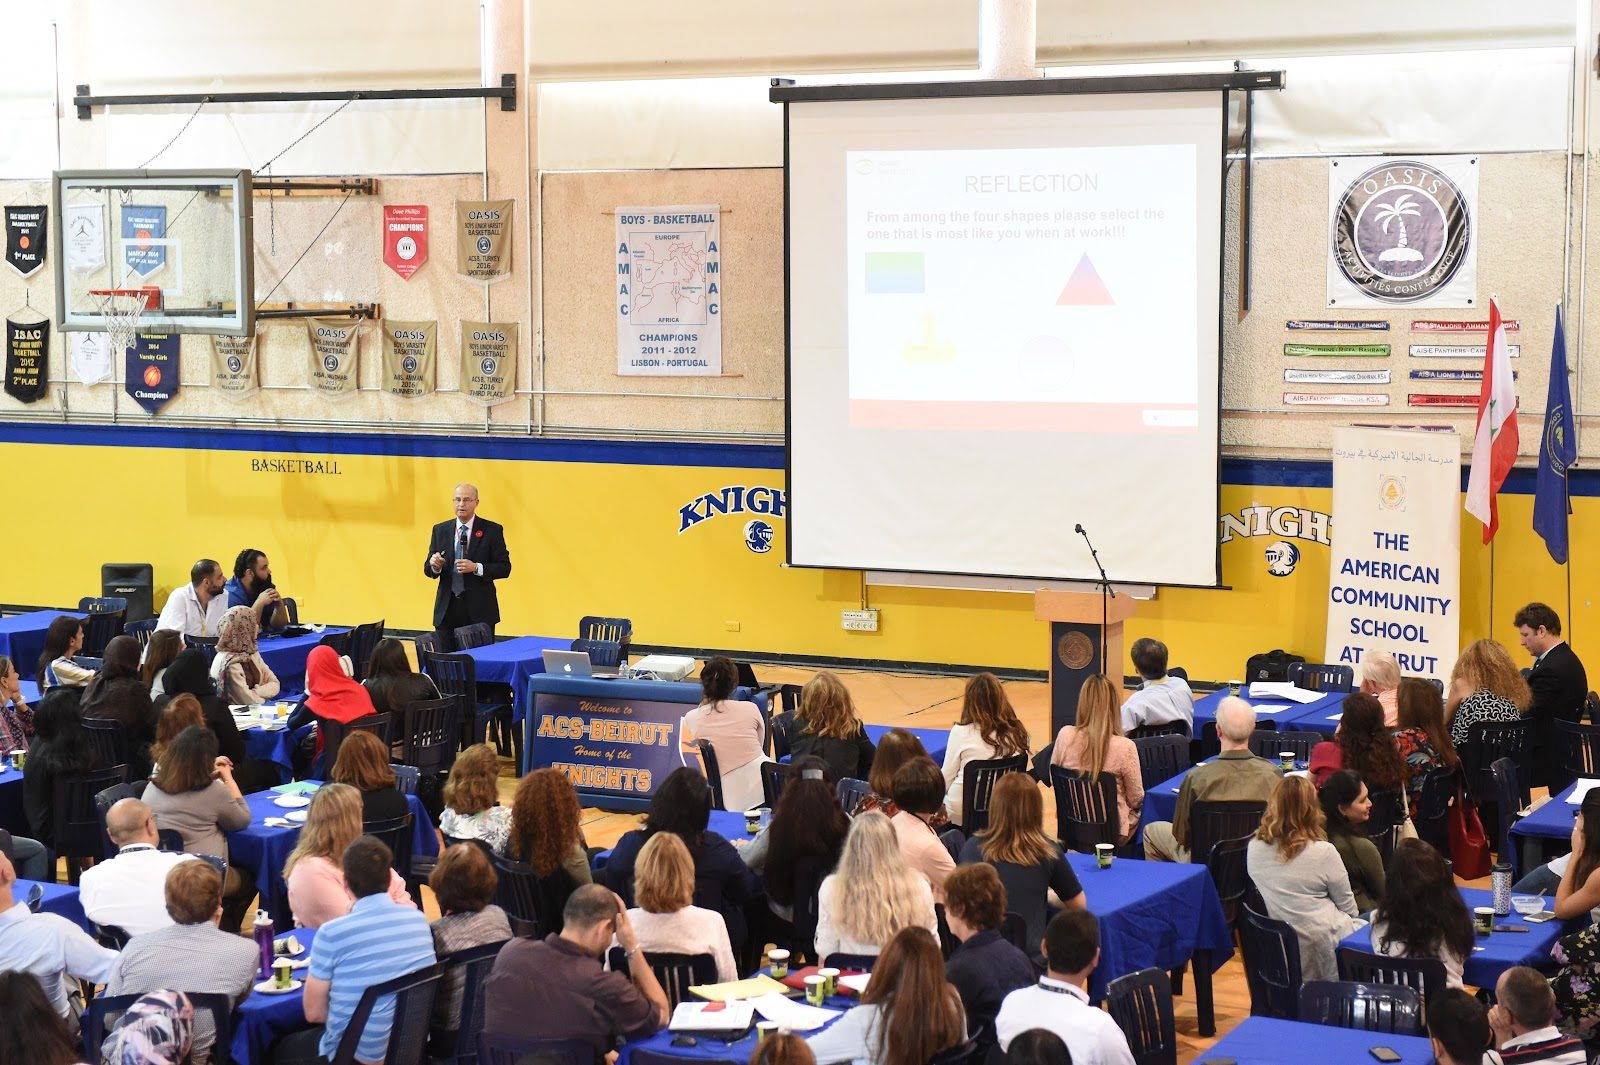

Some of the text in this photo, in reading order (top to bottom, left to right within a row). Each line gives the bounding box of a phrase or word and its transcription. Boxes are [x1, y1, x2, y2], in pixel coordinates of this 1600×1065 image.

[965, 173, 1098, 192] REFLECTION
[1363, 169, 1442, 195] OASIS
[468, 210, 500, 220] OASIS
[620, 215, 645, 224] BOYS
[653, 214, 714, 224] BASKETBALL
[866, 207, 1165, 225] From among the four shapes please select the
[389, 223, 424, 232] CHAMPIONS
[866, 225, 1126, 242] one that is most like you when at work!!!
[1344, 250, 1455, 294] ACTIVITIES CONFERENCE
[14, 330, 41, 340] ISAC
[318, 328, 346, 338] OASIS
[394, 330, 424, 340] OASIS
[473, 332, 504, 341] OASIS
[316, 346, 348, 355] BASKETBALL
[20, 358, 34, 366] 2012
[135, 390, 168, 400] Champions
[1335, 449, 1356, 459] بيروت
[1401, 451, 1426, 463] الجالية
[1428, 456, 1454, 465] مدرسة
[252, 458, 342, 474] BASKETBALL
[678, 486, 785, 535] KNIGH
[1220, 506, 1332, 546] NIGH
[1373, 531, 1409, 551] THE
[1340, 558, 1440, 584] AMERICAN
[1331, 586, 1451, 616] COMMUNITY
[1350, 618, 1429, 643] SCHOOL
[1340, 646, 1364, 664] AT
[580, 700, 632, 714] Welcome to
[537, 715, 673, 746] ACS-BEIRUT
[574, 745, 632, 762] Home of the
